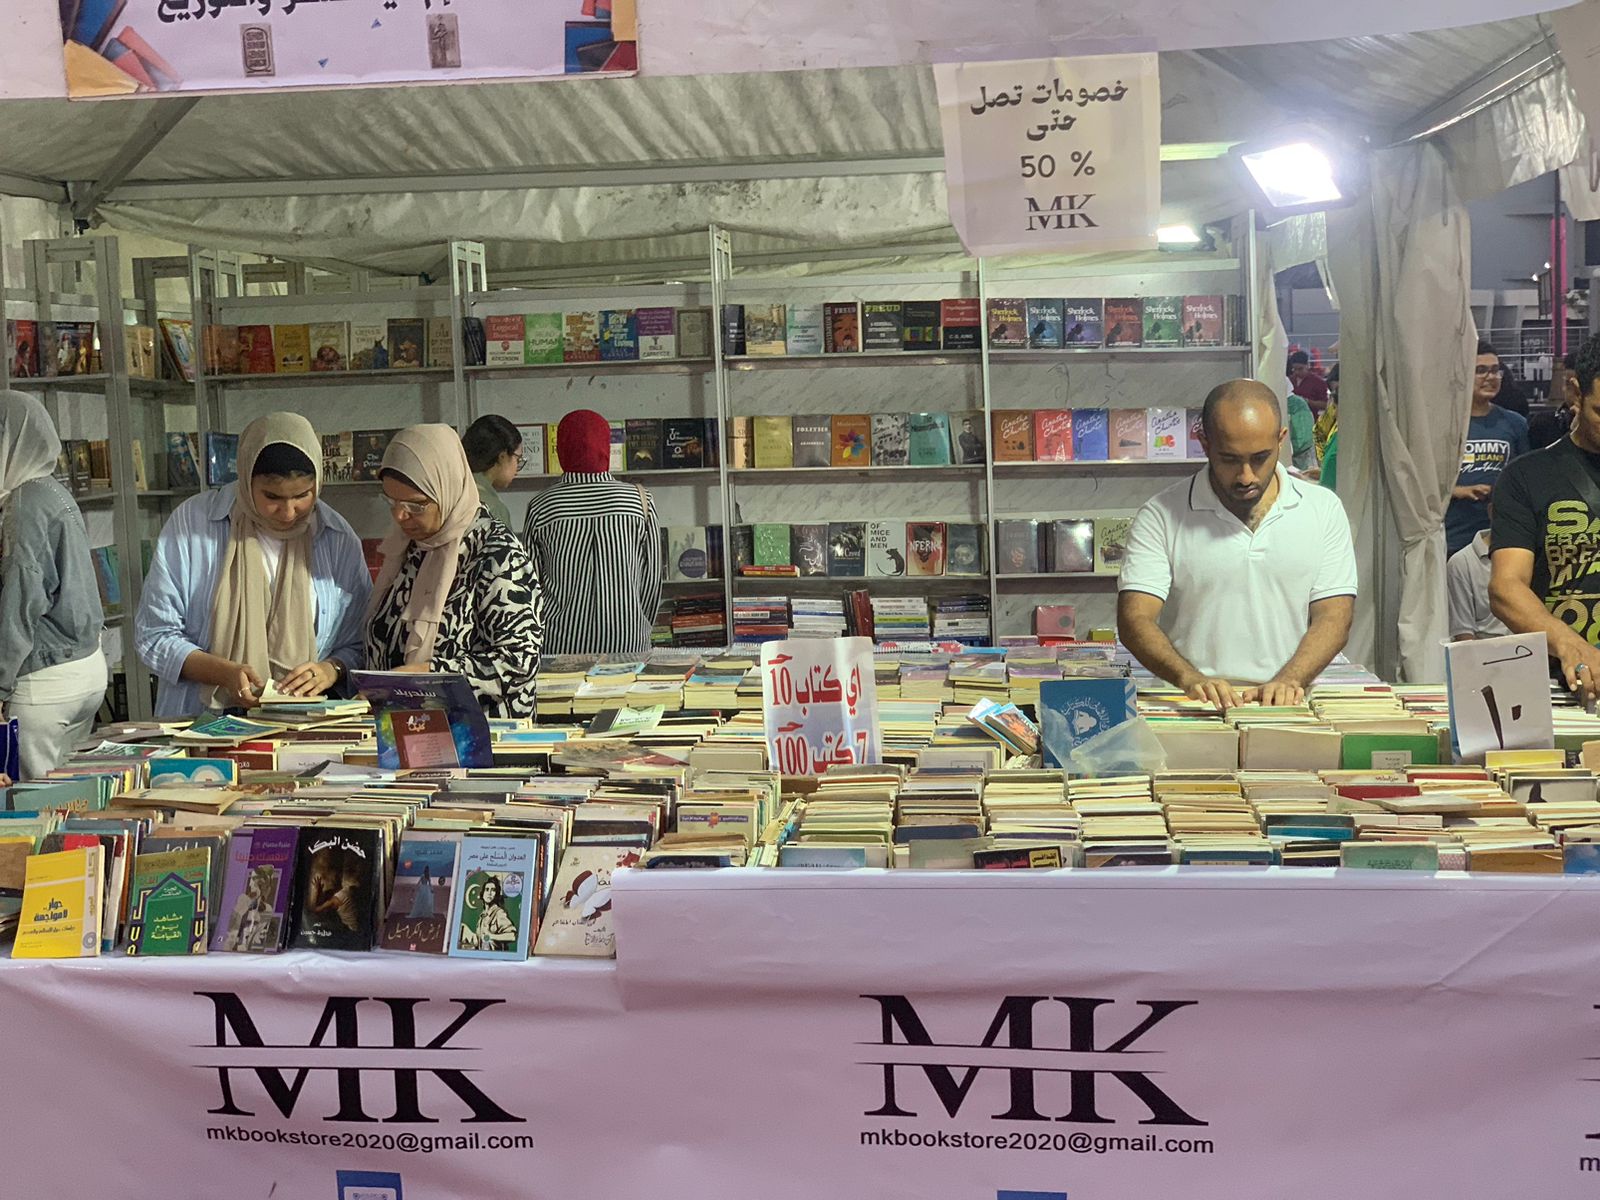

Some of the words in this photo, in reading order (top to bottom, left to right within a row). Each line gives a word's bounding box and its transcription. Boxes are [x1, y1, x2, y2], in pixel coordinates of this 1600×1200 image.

[970, 85, 1023, 115] تصل
[1031, 78, 1128, 107] خصومات
[1026, 109, 1077, 141] حتى
[1020, 154, 1056, 178] 50
[1070, 150, 1096, 177] %
[1024, 193, 1099, 231] MK
[865, 304, 900, 313] FREUD
[991, 307, 1019, 316] Sherlock
[1067, 306, 1095, 315] Sherlock
[1075, 314, 1100, 322] Holmes
[1145, 304, 1175, 313] Sherlock
[1153, 311, 1177, 320] Holmes
[1186, 303, 1214, 312] Sherlock
[1194, 311, 1218, 319] Holmes
[1464, 442, 1508, 454] OMMY
[770, 667, 792, 706] 10
[795, 664, 843, 716] كتاب
[775, 736, 808, 776] 100
[192, 991, 527, 1123] MK
[859, 994, 1209, 1127] MK
[206, 1126, 534, 1153] mkbookstore2020@gmail.com
[860, 1129, 1214, 1154] mkbookstore2020@gmail.com
